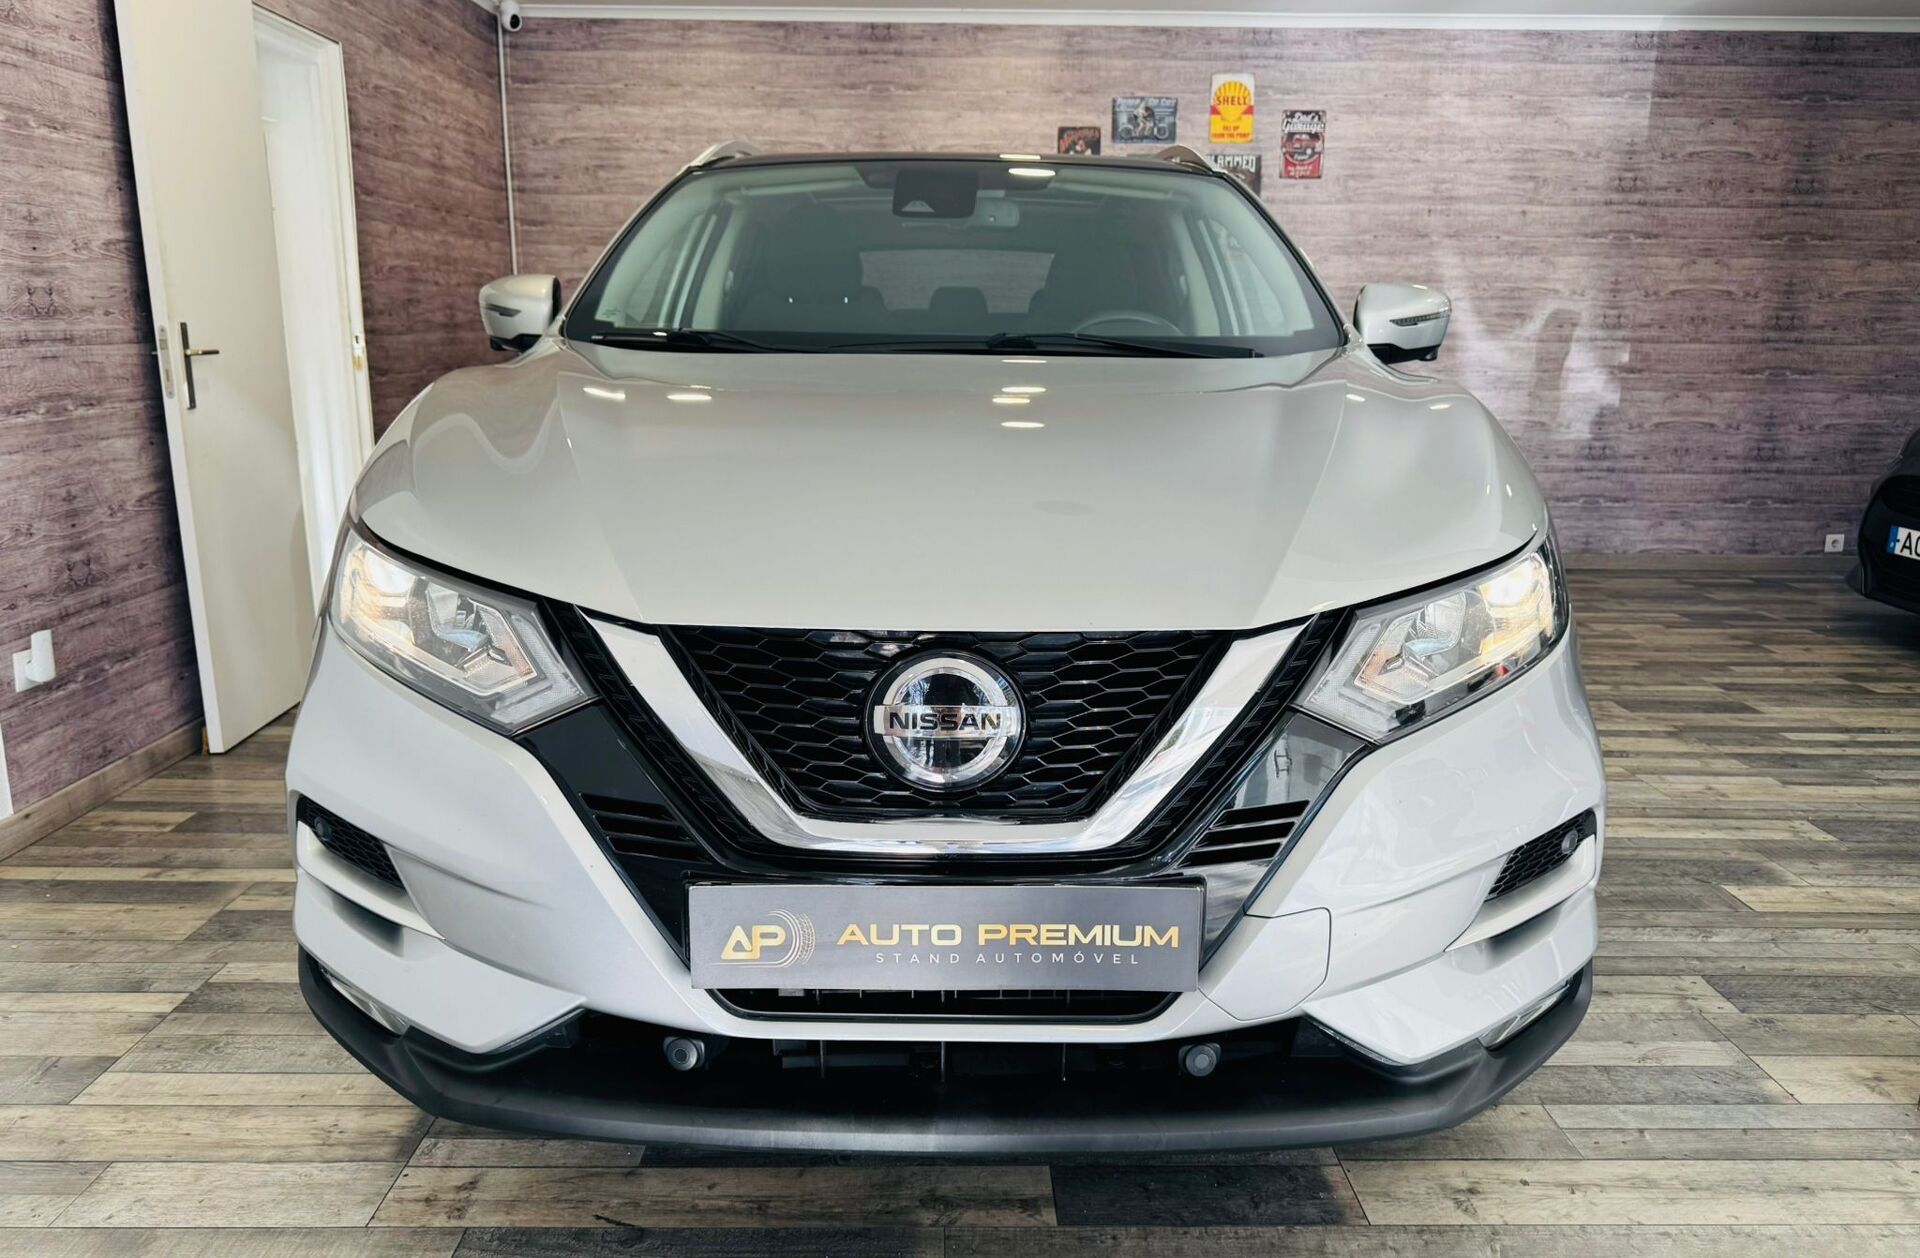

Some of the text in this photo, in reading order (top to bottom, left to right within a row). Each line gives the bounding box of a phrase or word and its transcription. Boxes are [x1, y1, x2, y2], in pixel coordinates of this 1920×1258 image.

[1215, 95, 1249, 106] SHELL
[889, 712, 1000, 731] NISSAN
[837, 923, 1179, 947] AUTO PREMIUM
[875, 951, 1138, 965] STAND AUTOMÓVEL
